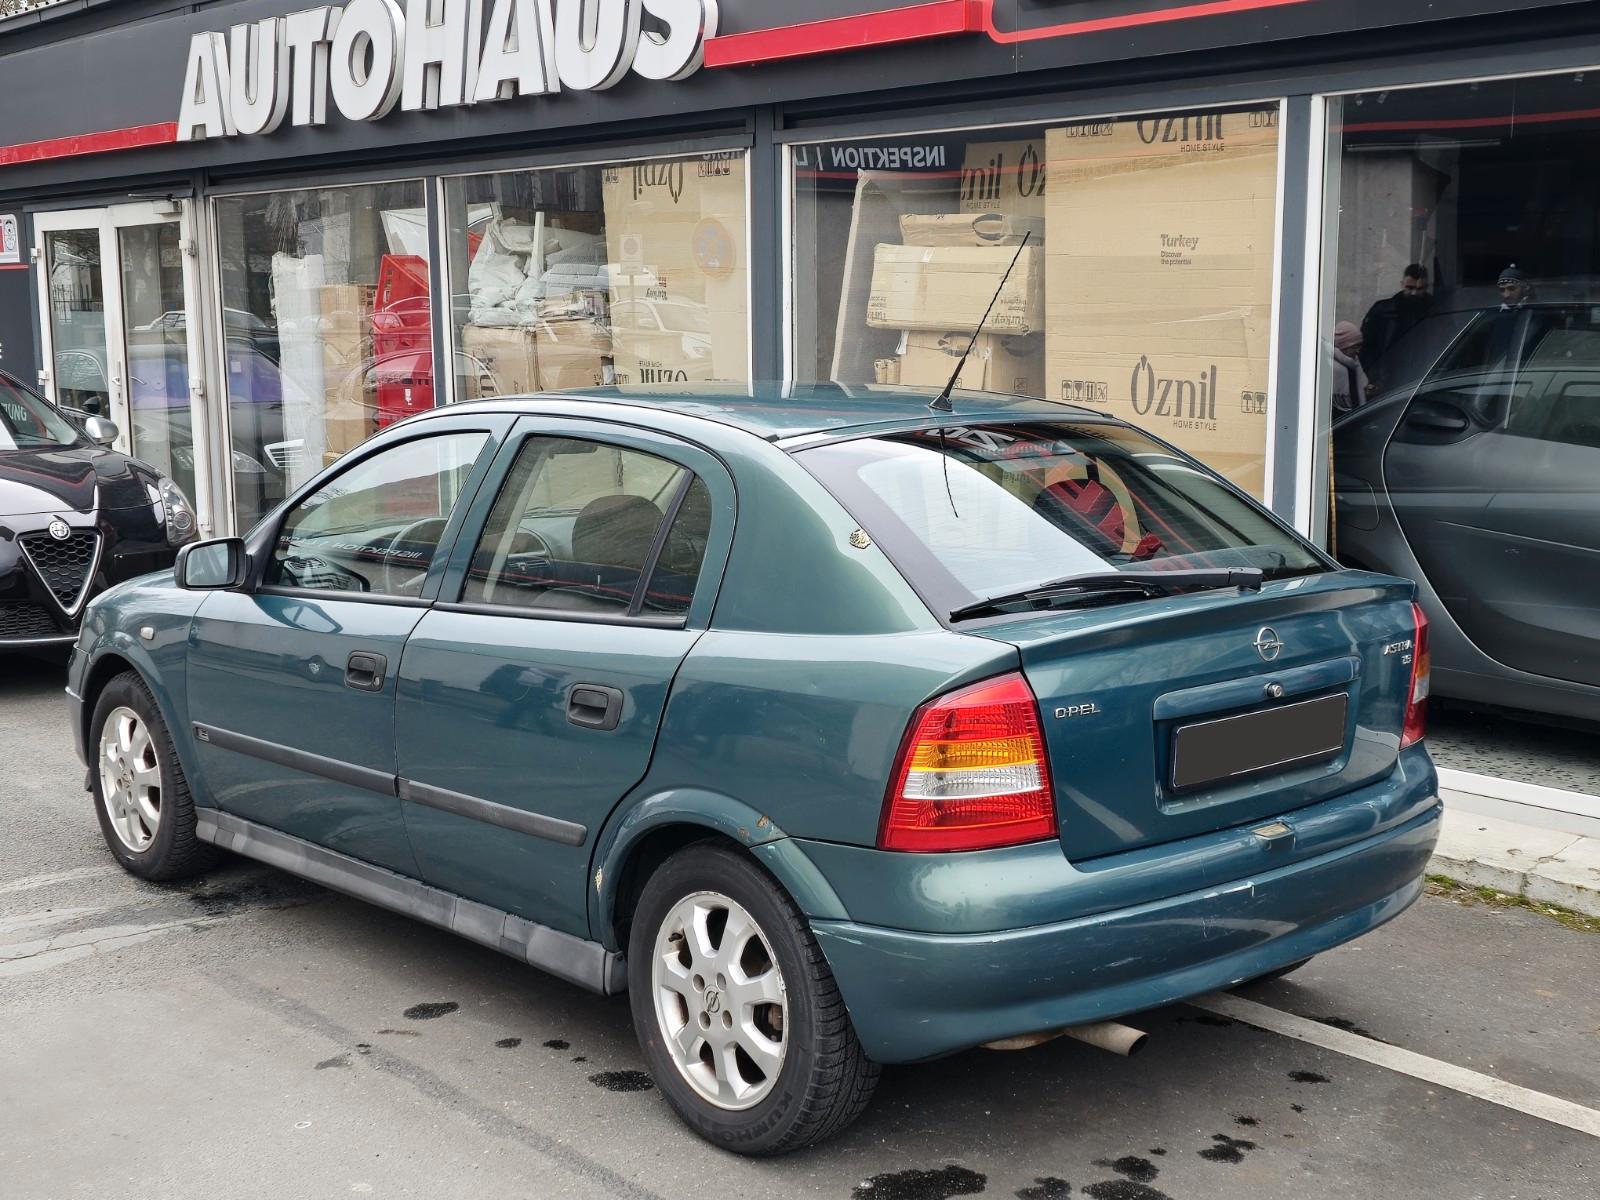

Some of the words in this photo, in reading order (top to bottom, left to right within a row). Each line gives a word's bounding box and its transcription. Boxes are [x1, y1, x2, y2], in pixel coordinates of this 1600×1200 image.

[177, 0, 718, 141] AUTOHAUS
[1160, 233, 1200, 250] Turkey
[1173, 420, 1193, 430] HOME
[1194, 421, 1217, 431] STYLE
[1055, 703, 1101, 719] OPEL
